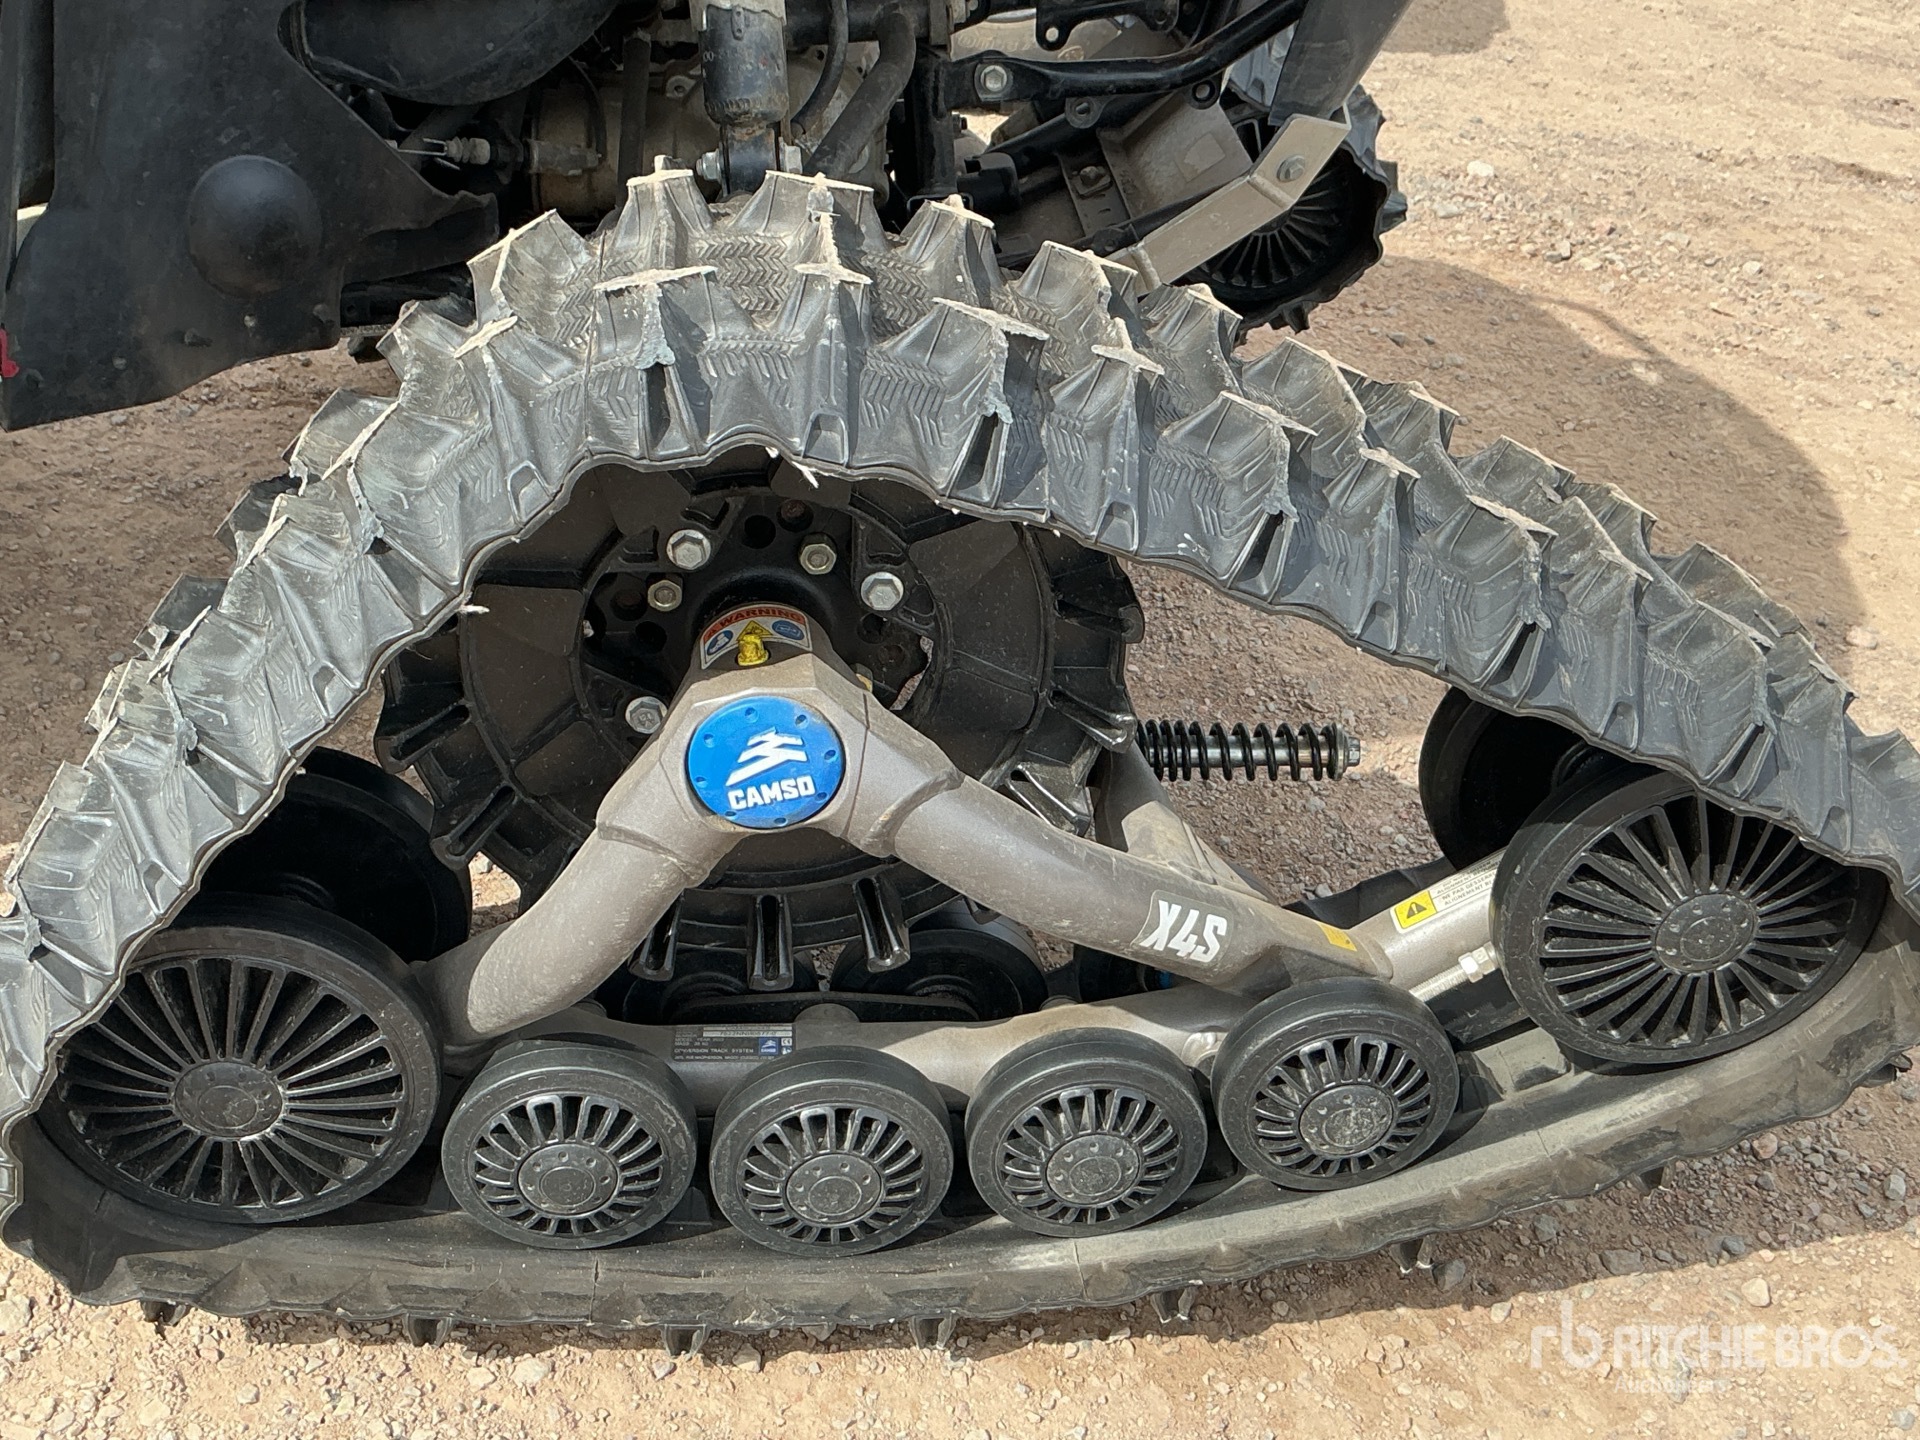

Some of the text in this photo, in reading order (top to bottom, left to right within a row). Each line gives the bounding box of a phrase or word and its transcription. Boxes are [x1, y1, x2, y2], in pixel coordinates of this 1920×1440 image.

[719, 607, 800, 627] WARNING
[727, 775, 816, 811] CAMSO
[1139, 900, 1227, 962] X4S
